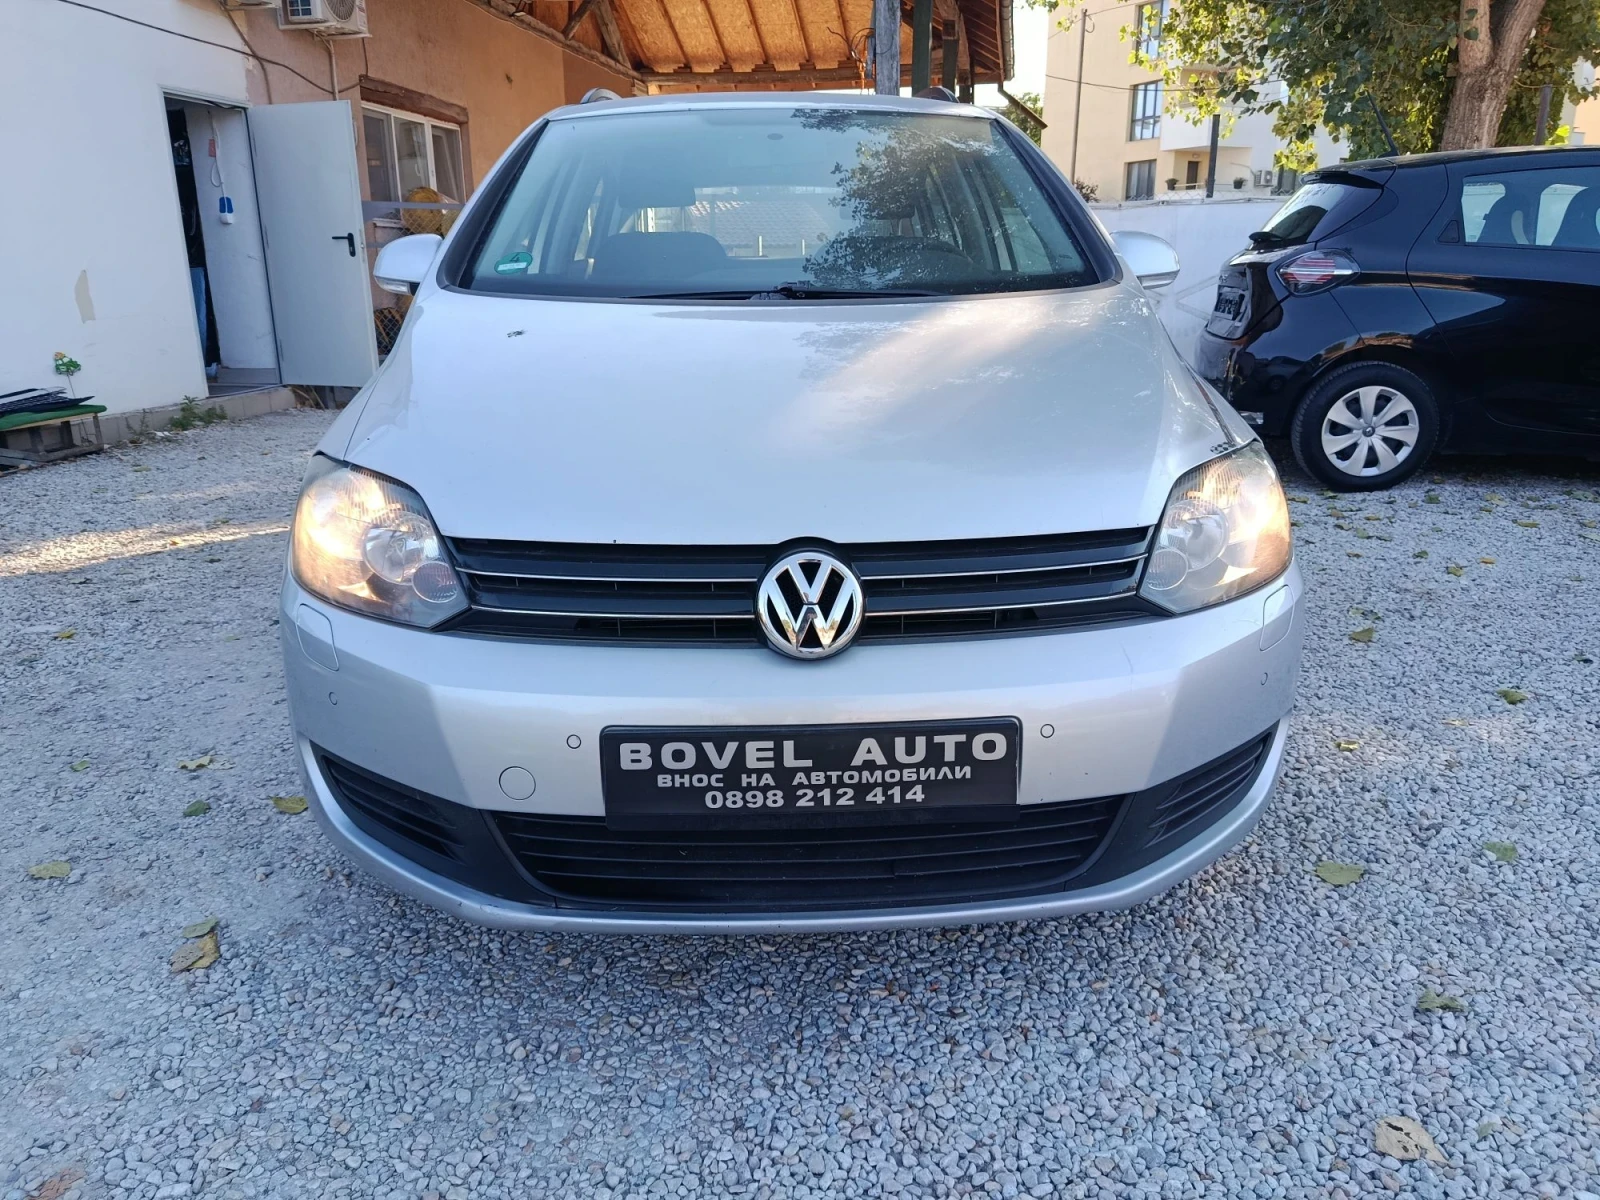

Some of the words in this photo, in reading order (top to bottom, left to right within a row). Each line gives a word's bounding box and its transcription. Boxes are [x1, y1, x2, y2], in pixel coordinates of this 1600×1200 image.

[619, 740, 813, 770] BOVEL
[850, 732, 1007, 766] AUTO
[657, 774, 724, 787] ВНОС
[741, 773, 776, 787] НА
[791, 765, 972, 786] АВТОМОБИЛИ
[705, 789, 784, 809] 0898
[795, 787, 855, 807] 212
[865, 784, 925, 805] 414
